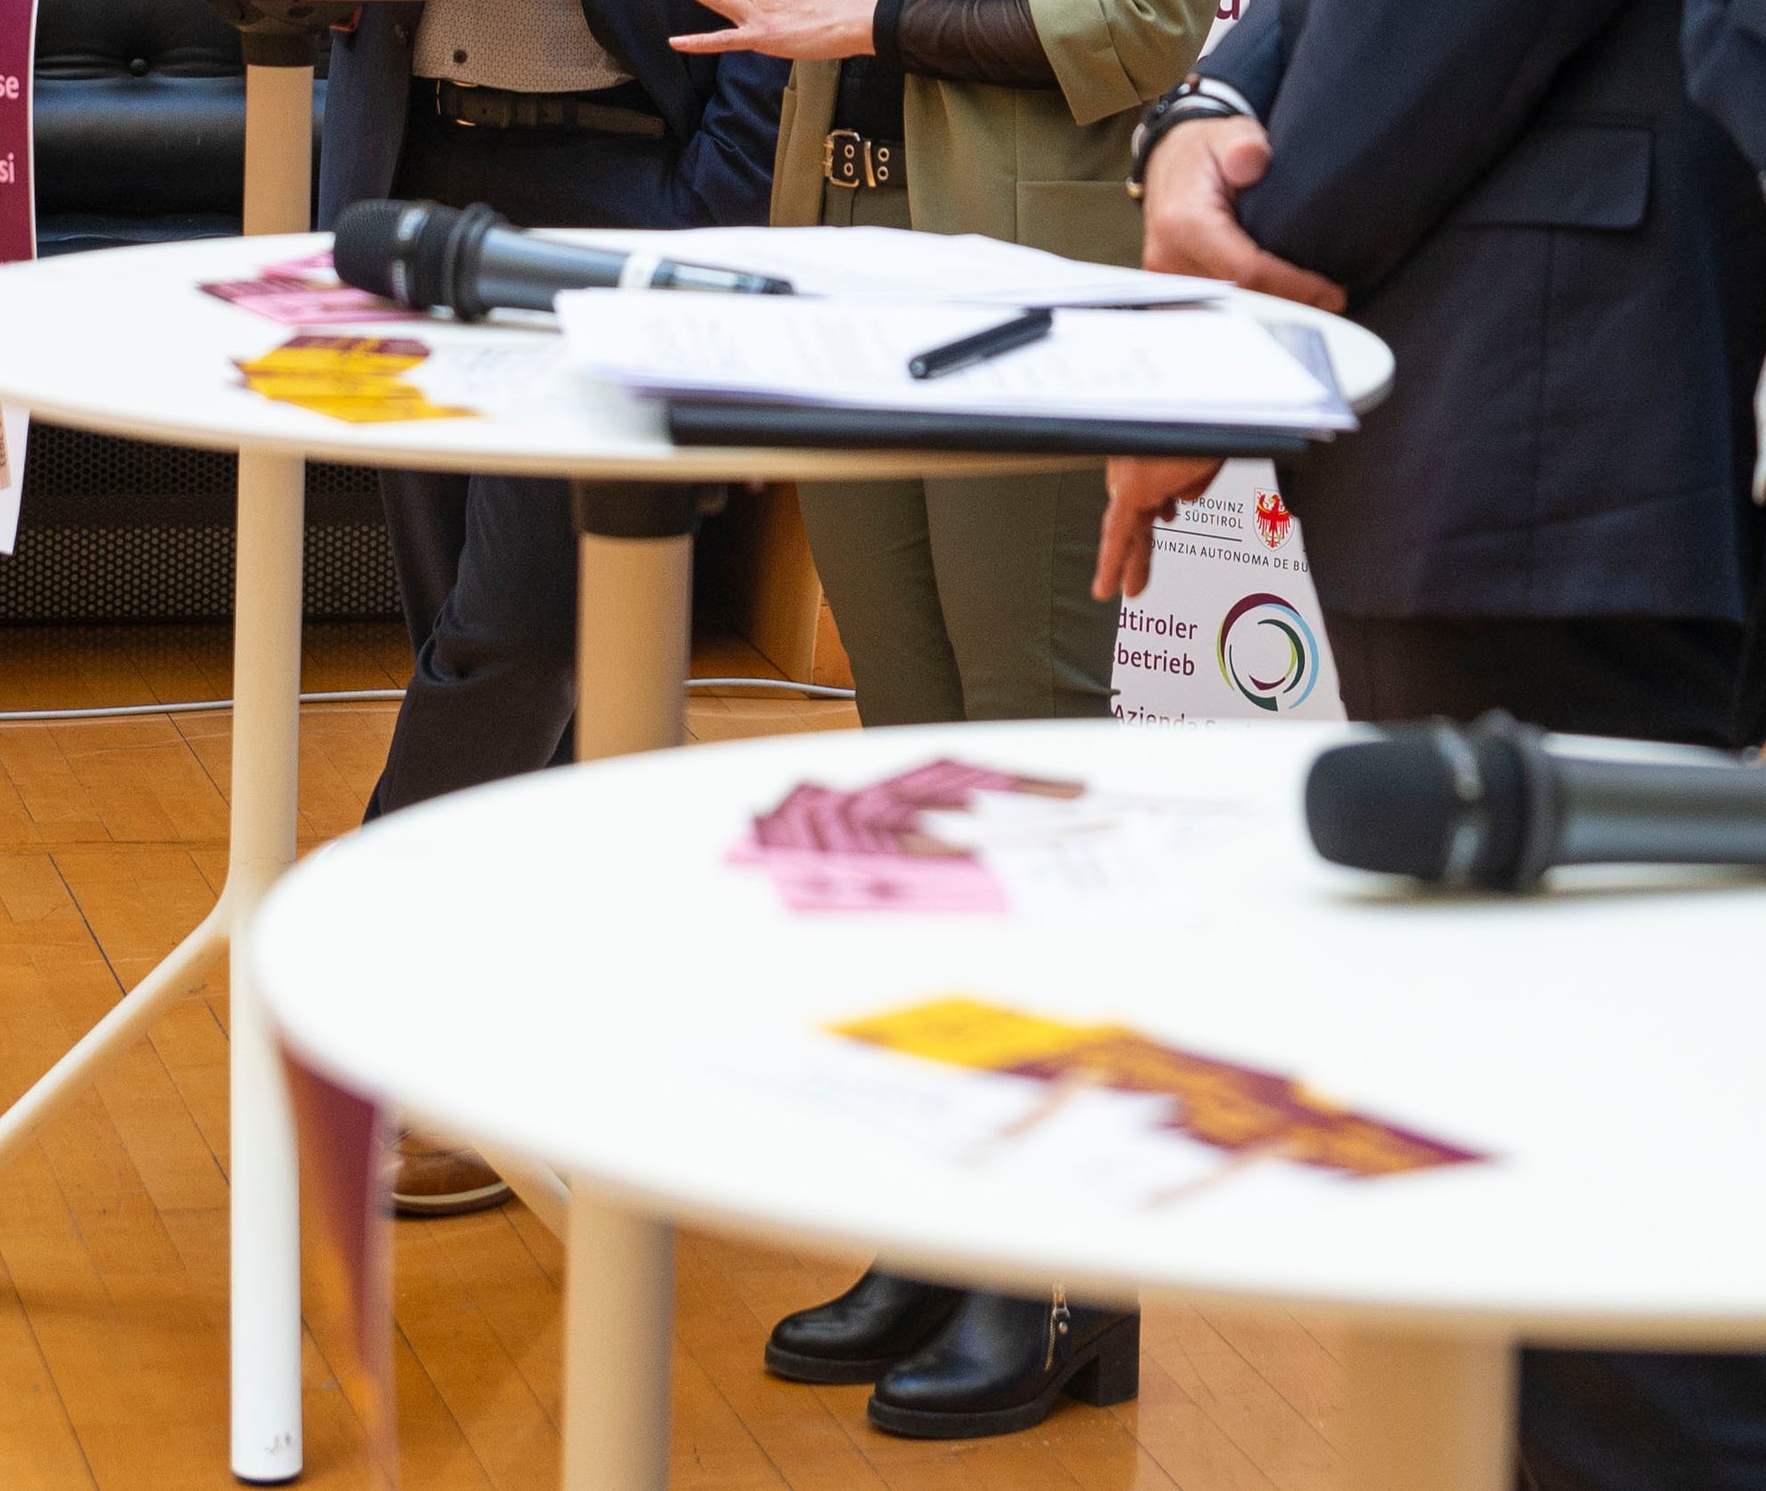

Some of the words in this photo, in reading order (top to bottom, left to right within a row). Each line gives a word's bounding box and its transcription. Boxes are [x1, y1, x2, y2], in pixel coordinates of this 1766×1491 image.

[1185, 509, 1243, 529] SÜDTIROL
[1200, 546, 1270, 567] AUTONOMA
[1273, 558, 1289, 570] DE
[1117, 607, 1198, 640] dtiroler
